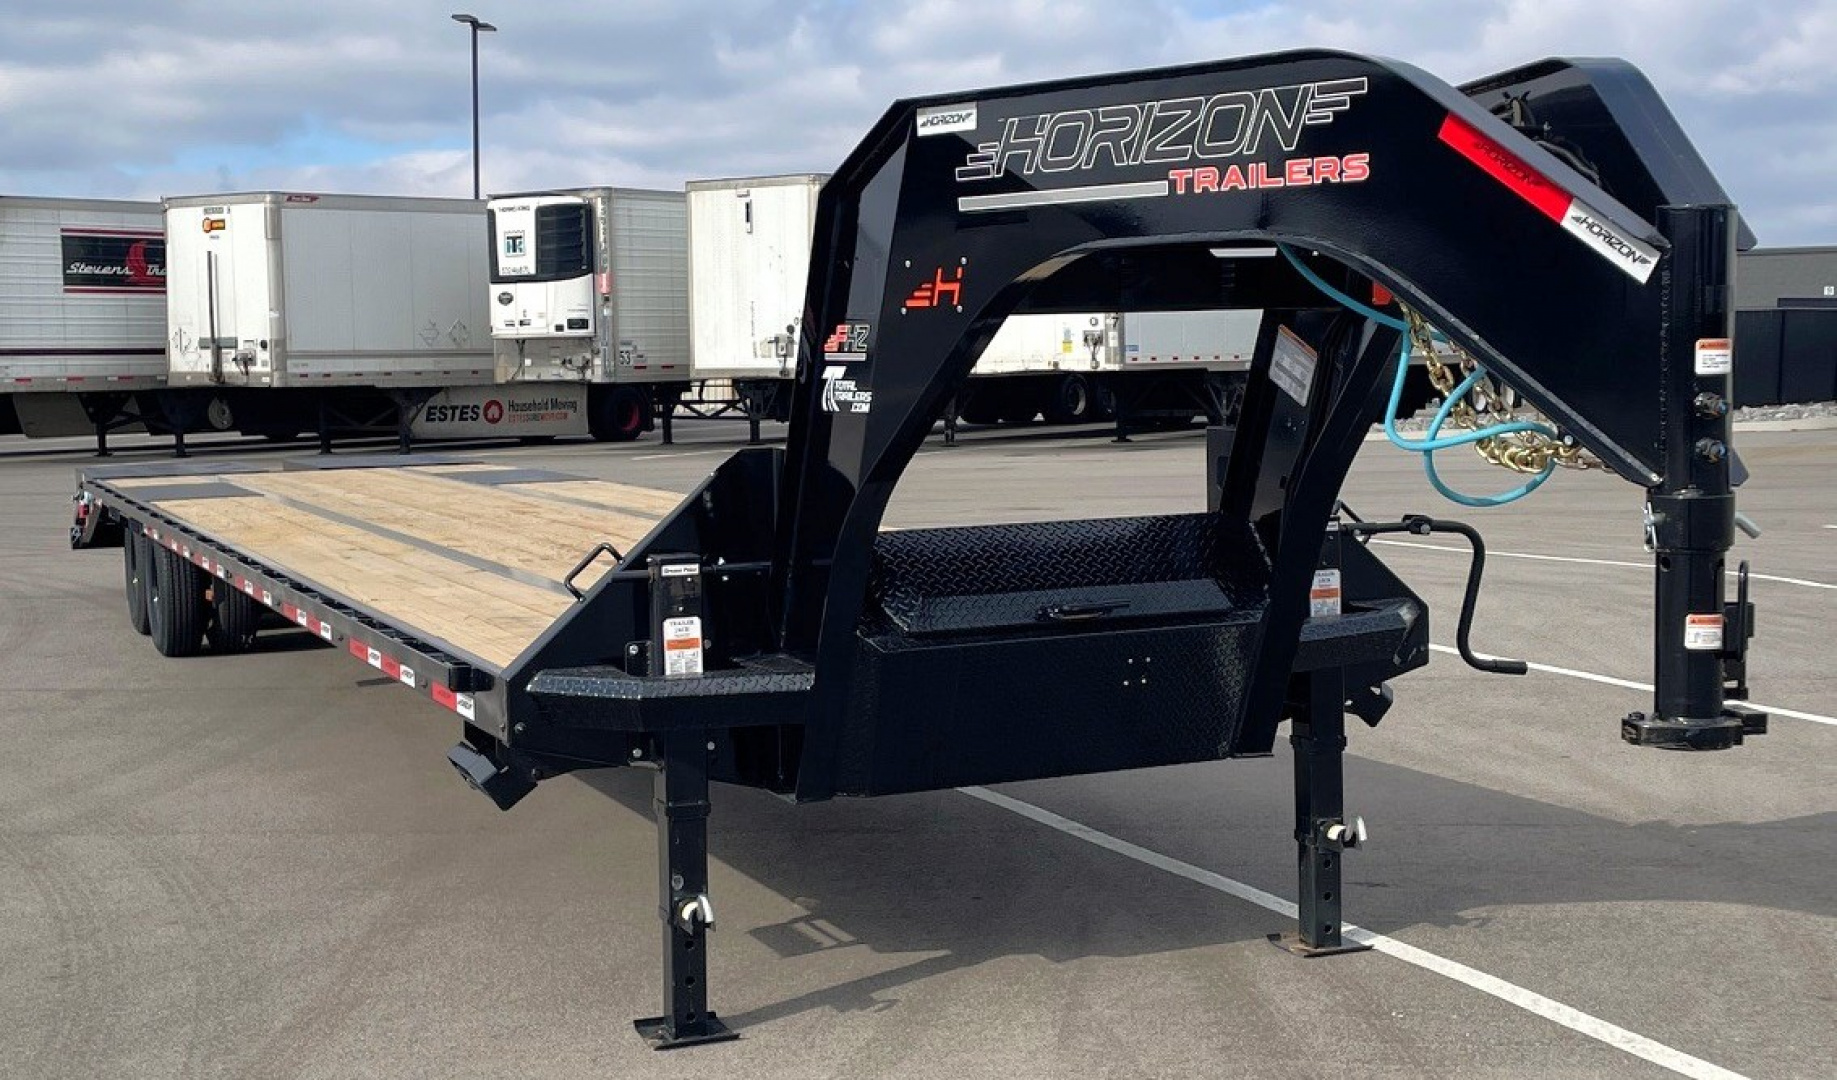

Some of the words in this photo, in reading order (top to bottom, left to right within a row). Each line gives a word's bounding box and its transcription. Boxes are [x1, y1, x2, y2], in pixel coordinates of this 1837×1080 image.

[993, 84, 1313, 178] HORIZON
[1168, 153, 1370, 195] TRAILERS
[1580, 215, 1642, 265] HORIZON
[66, 261, 134, 275] Stevens
[425, 404, 480, 422] ESTES
[508, 398, 548, 412] Household
[550, 397, 578, 412] Moving
